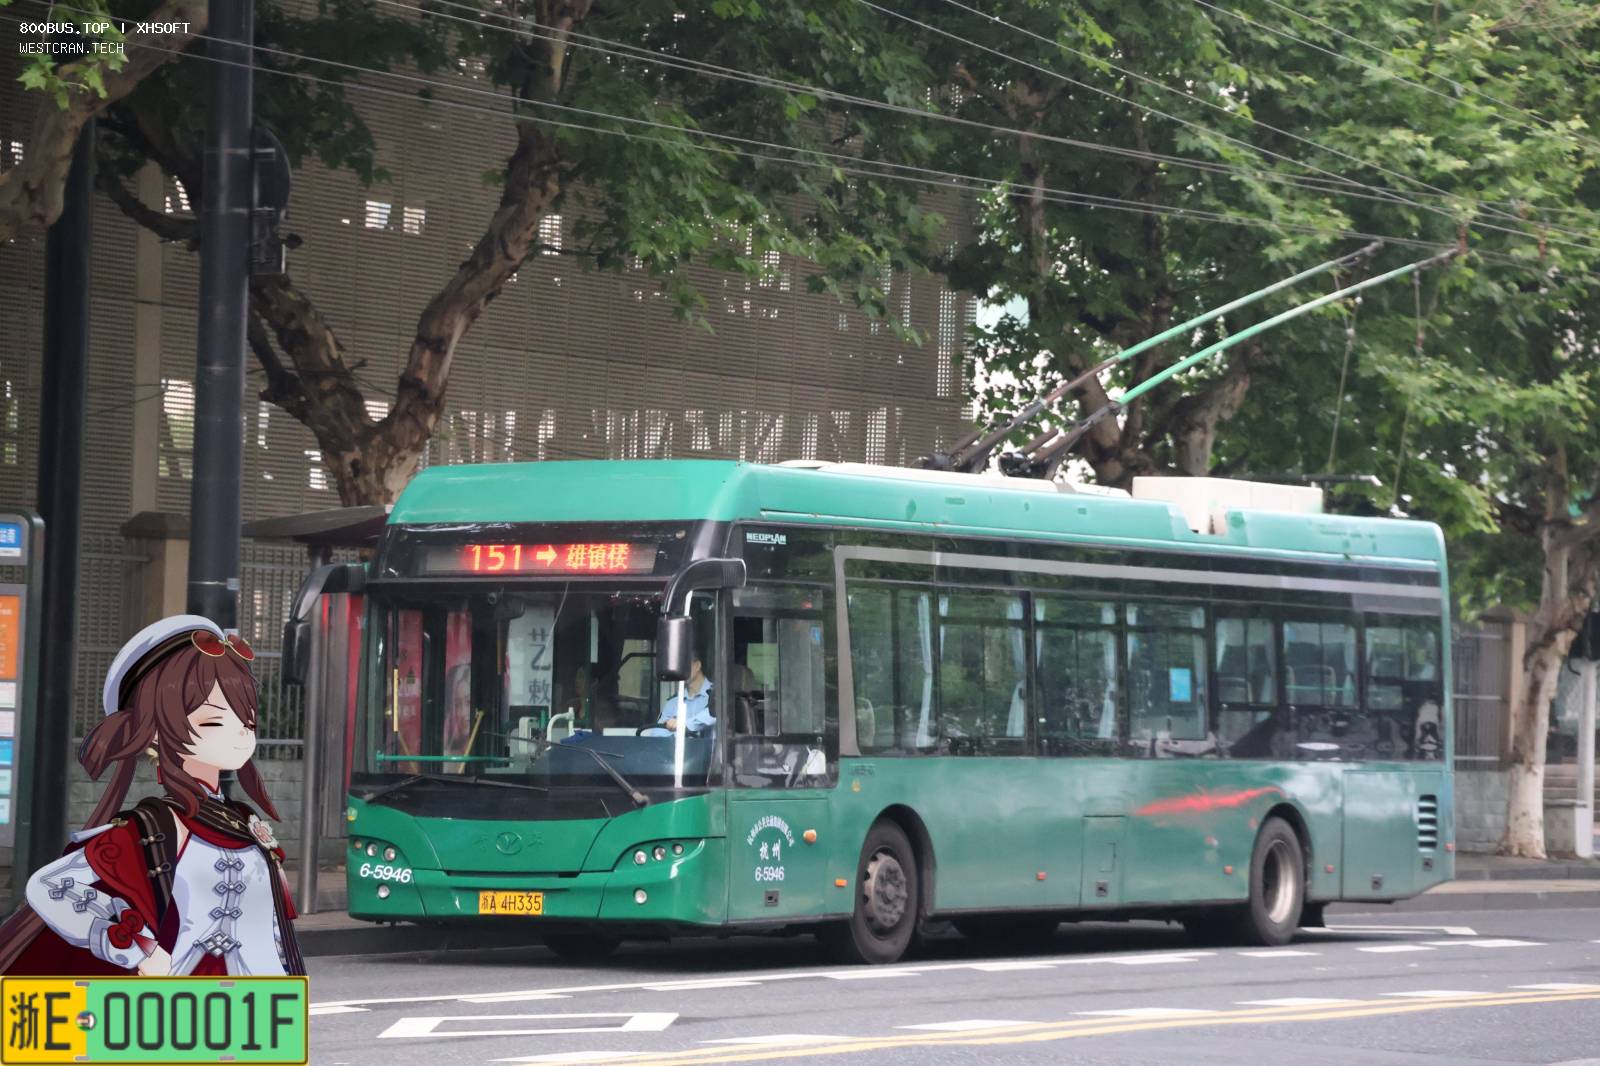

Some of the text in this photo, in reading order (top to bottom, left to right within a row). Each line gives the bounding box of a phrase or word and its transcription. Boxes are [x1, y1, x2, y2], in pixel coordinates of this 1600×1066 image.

[746, 532, 786, 544] NEOPLAN
[471, 544, 521, 571] 151
[359, 862, 412, 883] 6-5946
[755, 866, 785, 881] 6-5946
